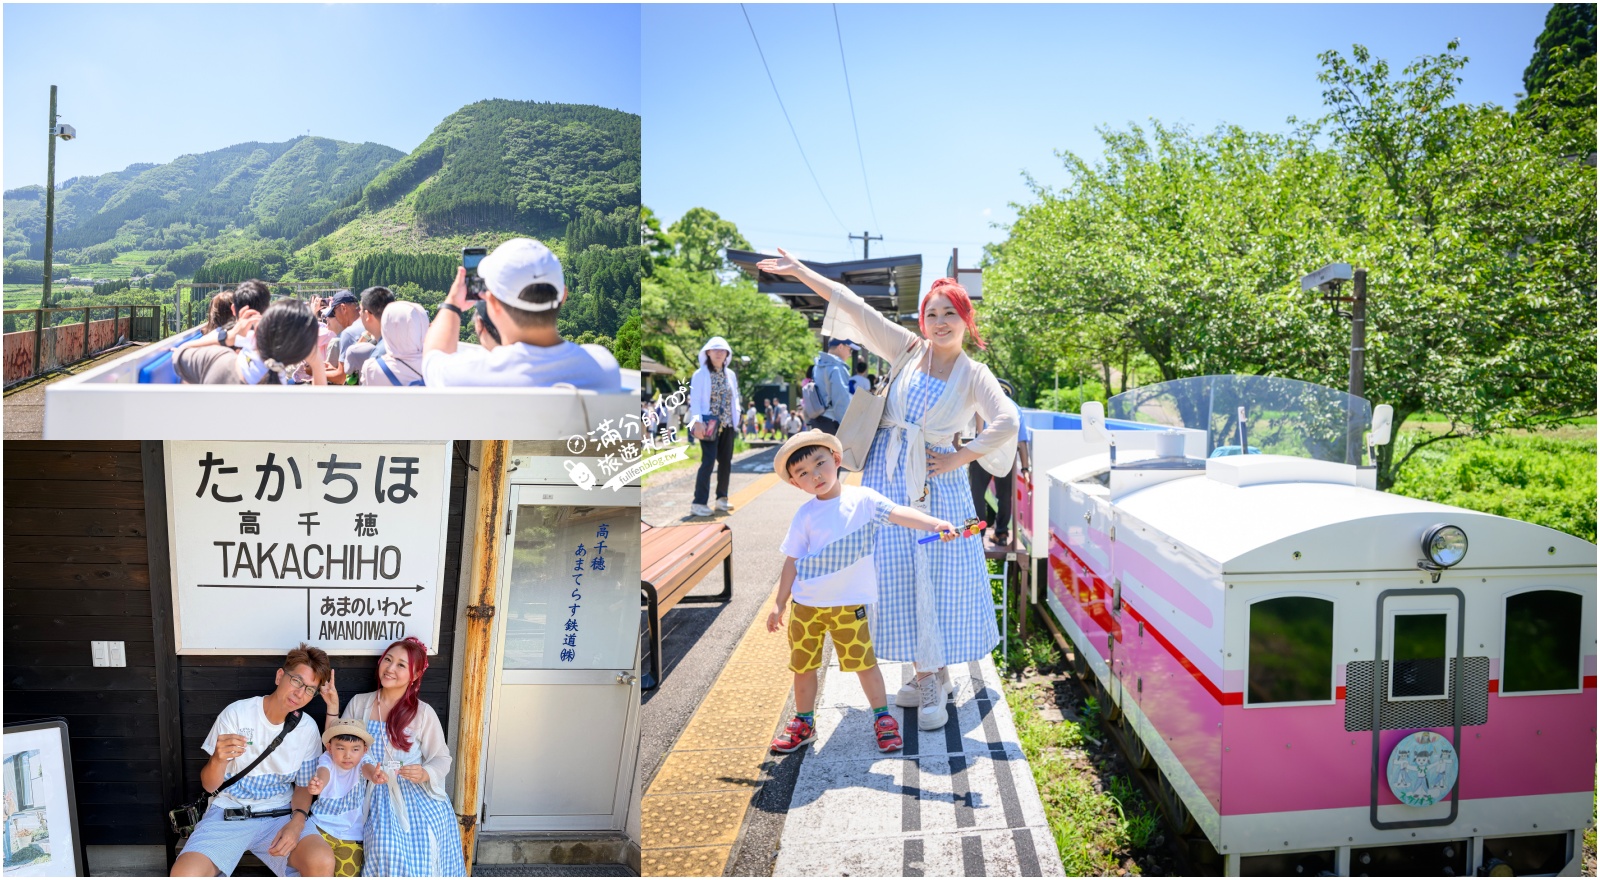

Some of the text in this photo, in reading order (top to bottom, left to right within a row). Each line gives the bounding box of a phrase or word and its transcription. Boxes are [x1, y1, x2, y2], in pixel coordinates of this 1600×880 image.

[195, 451, 420, 504] たかちほ
[238, 510, 379, 537] 高千穂
[213, 541, 402, 580] TAKACHIHO
[320, 596, 413, 617] あまのいわと
[318, 620, 406, 641] AMANOIWATO
